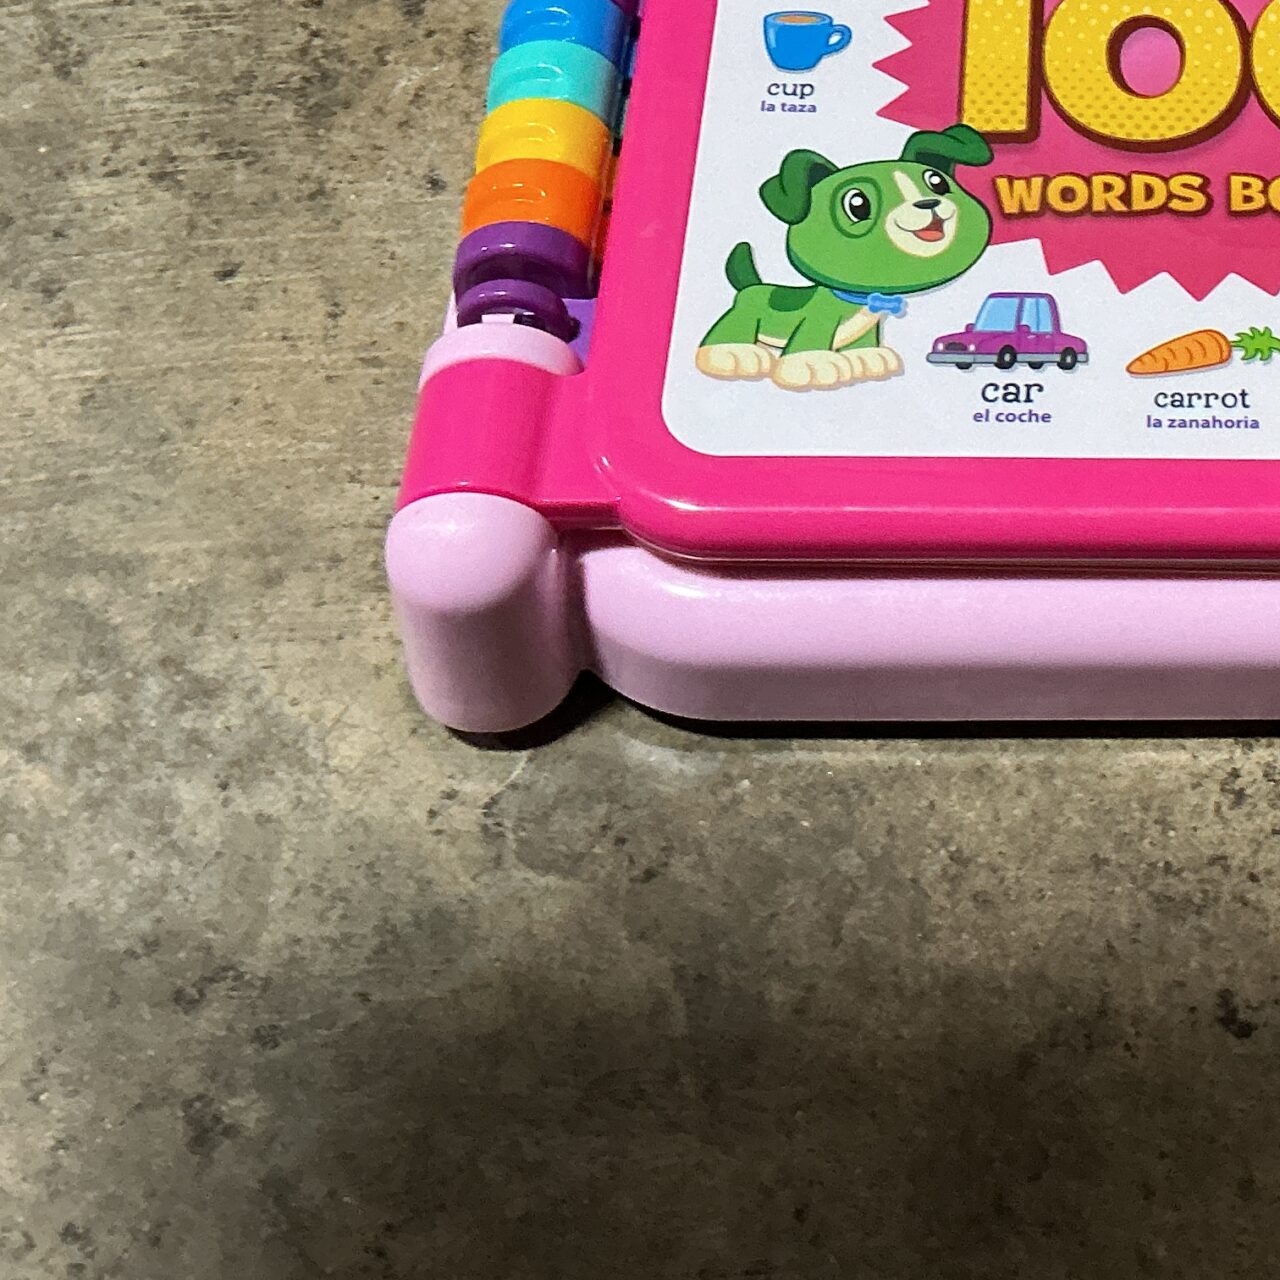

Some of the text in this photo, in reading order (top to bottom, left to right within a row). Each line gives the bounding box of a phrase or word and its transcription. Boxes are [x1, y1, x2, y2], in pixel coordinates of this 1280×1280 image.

[766, 81, 815, 99] cup
[760, 101, 817, 114] la taza
[994, 171, 1211, 218] WORDS
[980, 380, 1044, 404] car
[1153, 388, 1251, 410] carrot
[973, 408, 1052, 424] el coche
[1146, 414, 1260, 430] la zanahoria
